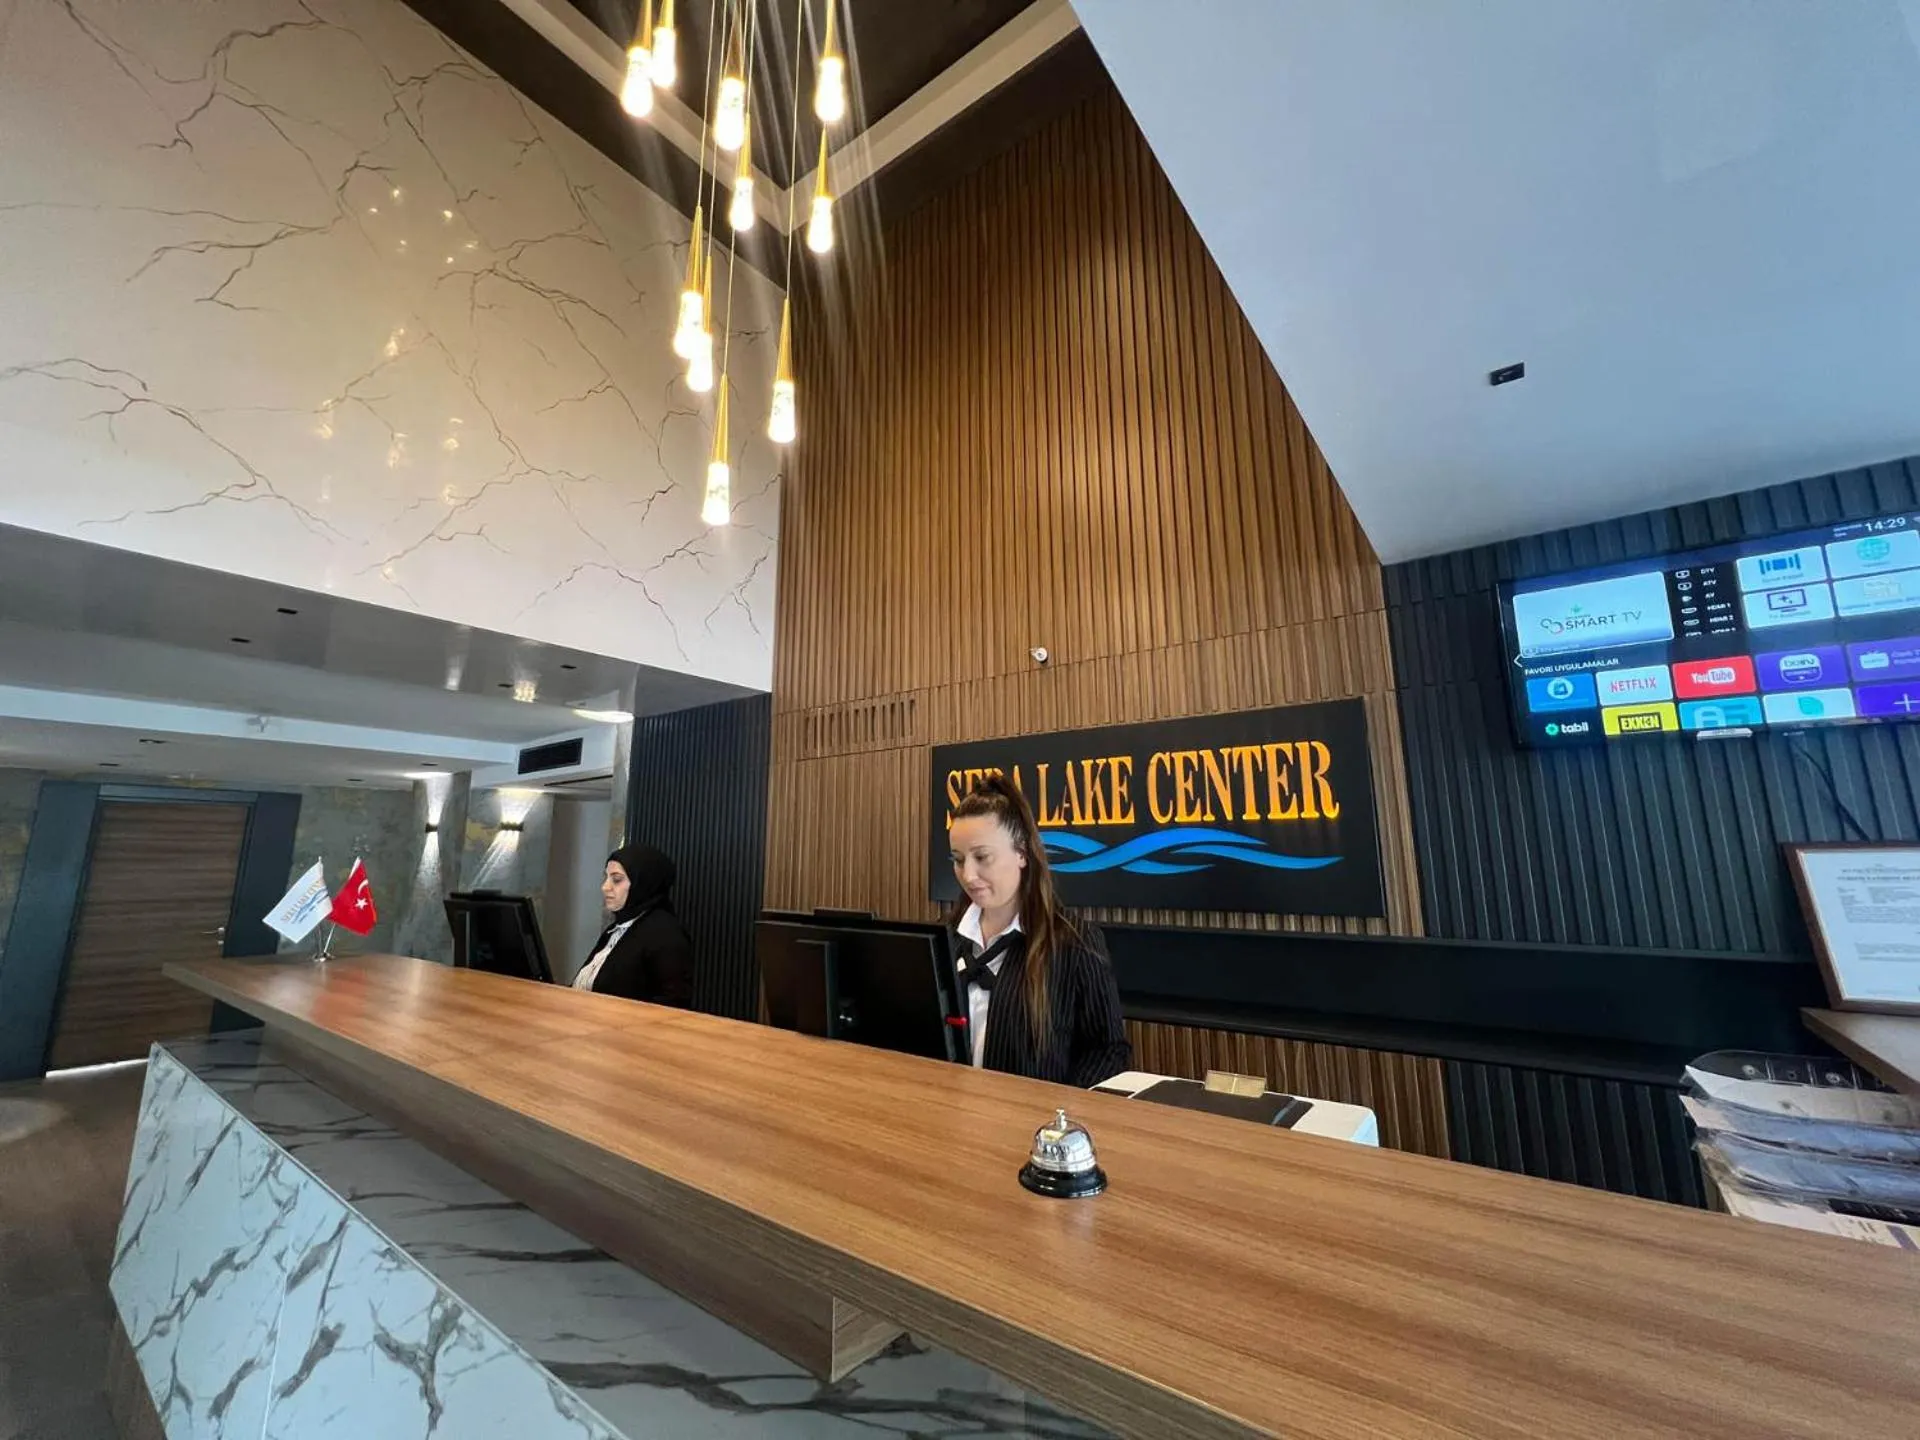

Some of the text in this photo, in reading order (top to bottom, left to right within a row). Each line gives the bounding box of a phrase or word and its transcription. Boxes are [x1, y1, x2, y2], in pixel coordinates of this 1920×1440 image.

[1865, 517, 1906, 532] 14:29
[1565, 614, 1618, 631] SMART
[1622, 610, 1643, 622] TV
[1555, 658, 1620, 673] UYGULAMALAR
[1691, 667, 1734, 684] YouTube
[1608, 677, 1658, 693] NETFLIX
[1620, 714, 1661, 731] EXXEN
[1036, 755, 1136, 827] LAKE
[1146, 740, 1341, 825] CENTER
